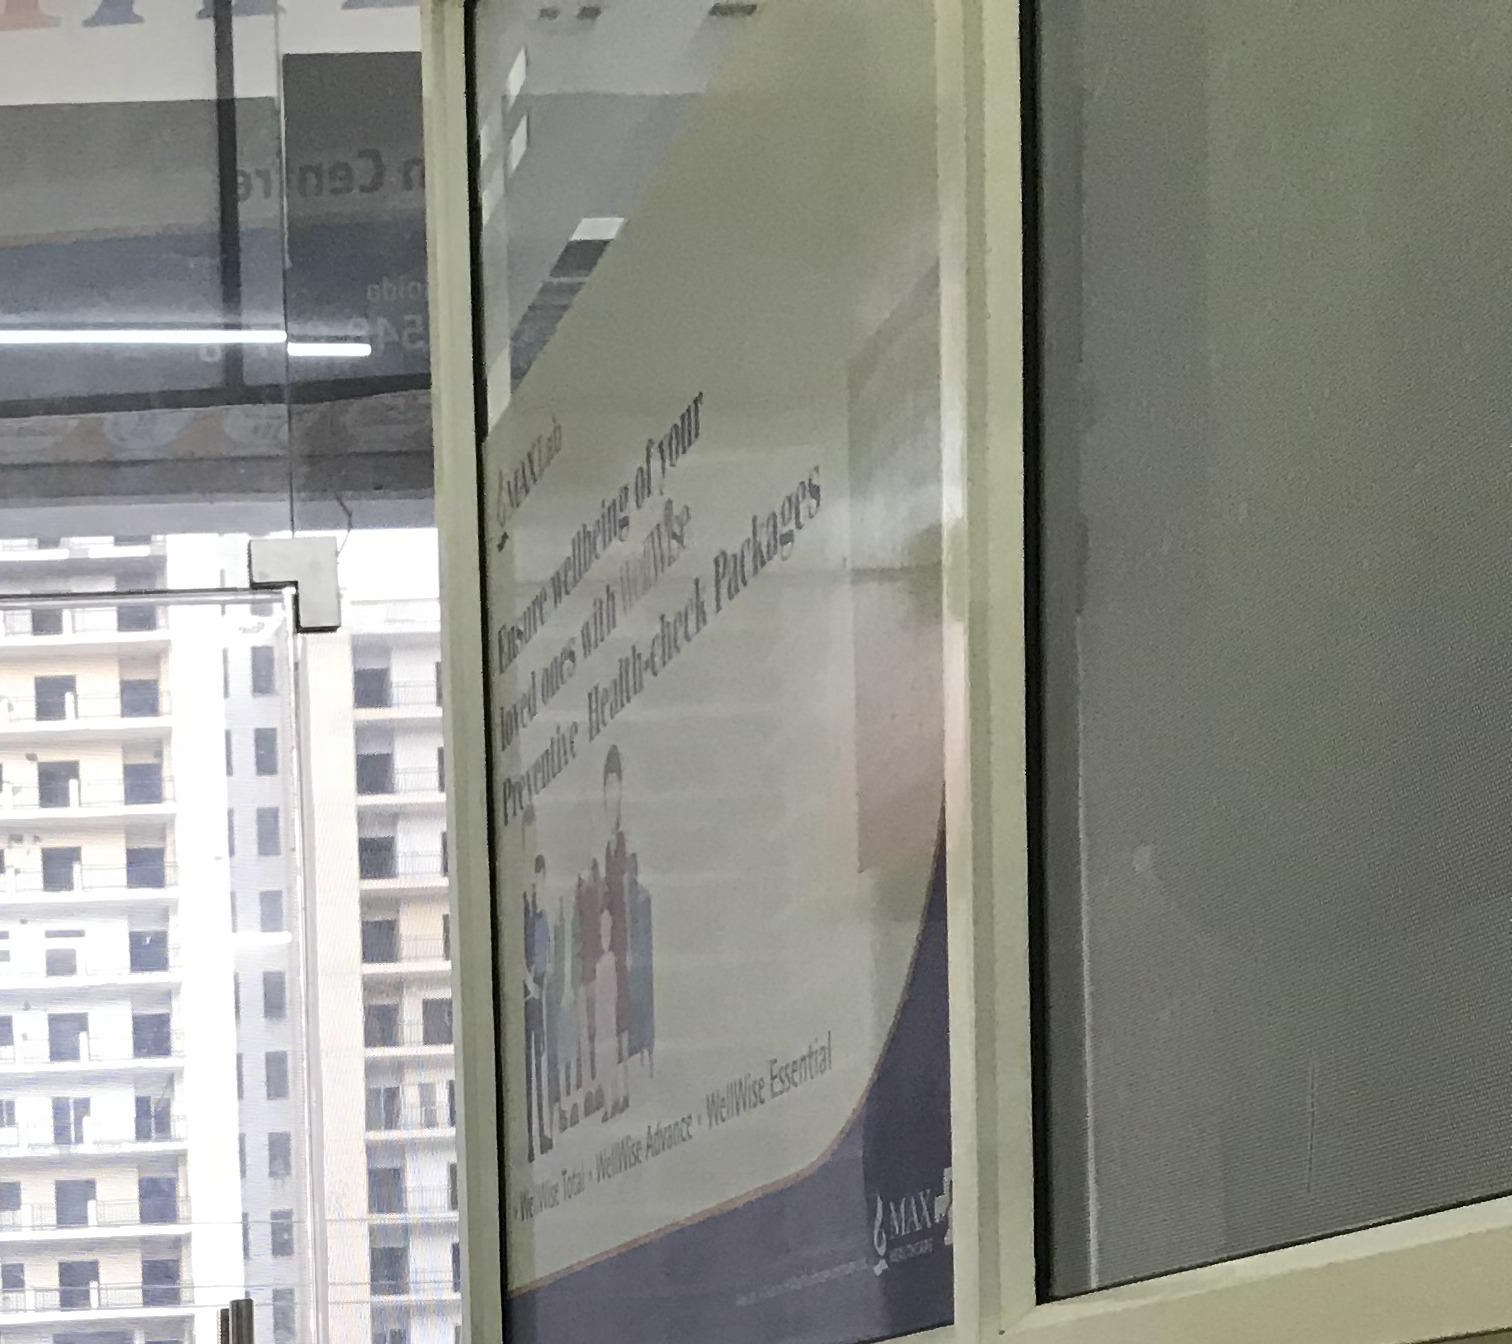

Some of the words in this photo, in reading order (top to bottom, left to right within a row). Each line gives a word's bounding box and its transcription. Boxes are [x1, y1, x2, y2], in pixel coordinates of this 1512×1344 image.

[498, 585, 548, 674] Ensure
[550, 485, 629, 608] wellbeing
[635, 438, 655, 510] of
[656, 392, 702, 496] your
[500, 670, 537, 752] loved
[541, 637, 576, 704] ones
[581, 584, 617, 659] with
[503, 720, 578, 826] Preventive
[588, 577, 707, 743] Health-check
[713, 464, 821, 614] Packages
[561, 1168, 585, 1200] Total
[595, 1135, 642, 1184] WellWise
[645, 1112, 693, 1161] Advance
[706, 1073, 765, 1129] WellWise
[769, 1030, 832, 1100] Essential
[889, 1189, 933, 1236] MAX
